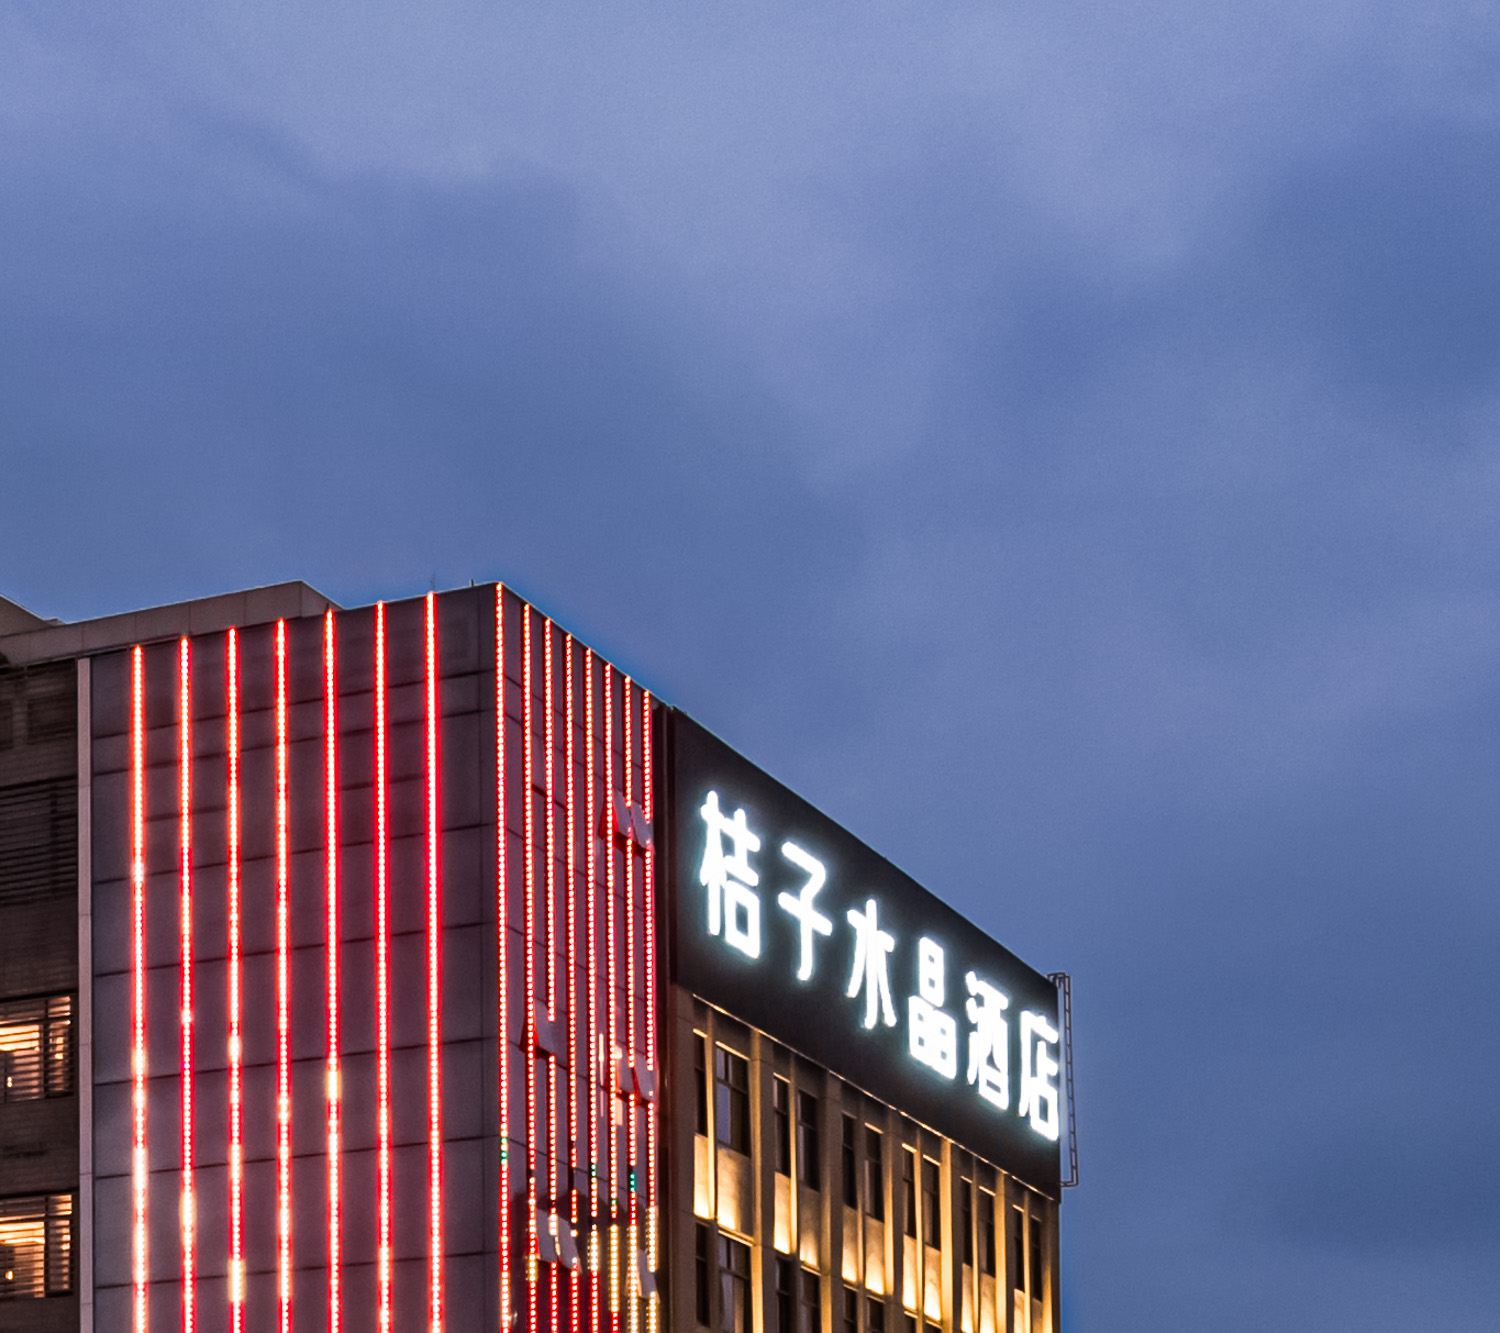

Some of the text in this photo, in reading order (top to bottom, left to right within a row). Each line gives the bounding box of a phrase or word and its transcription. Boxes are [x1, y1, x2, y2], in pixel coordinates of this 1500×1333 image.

[697, 789, 1060, 1142] 桔子水晶酒店
